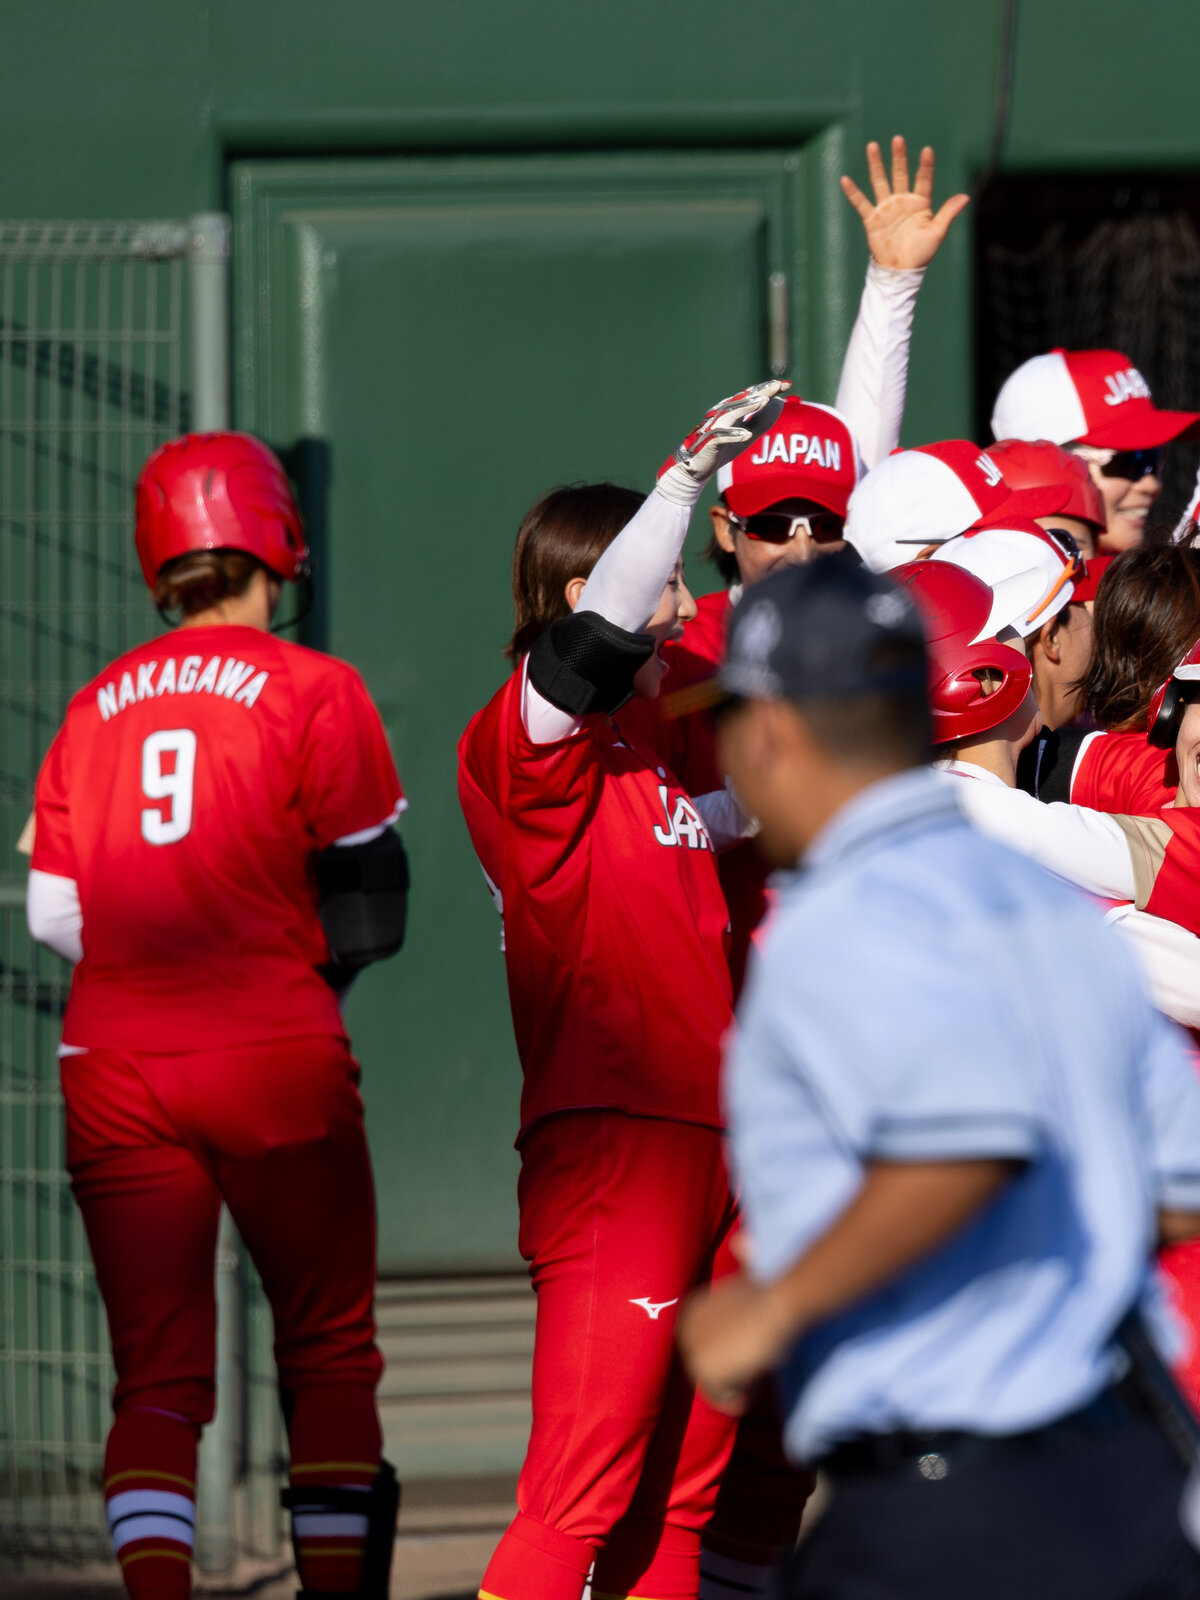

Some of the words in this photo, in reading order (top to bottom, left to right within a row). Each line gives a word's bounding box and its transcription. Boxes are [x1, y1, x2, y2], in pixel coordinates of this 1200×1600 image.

[751, 433, 841, 471] JAPAN
[97, 655, 270, 722] NAKAGAWA
[141, 728, 197, 847] 9
